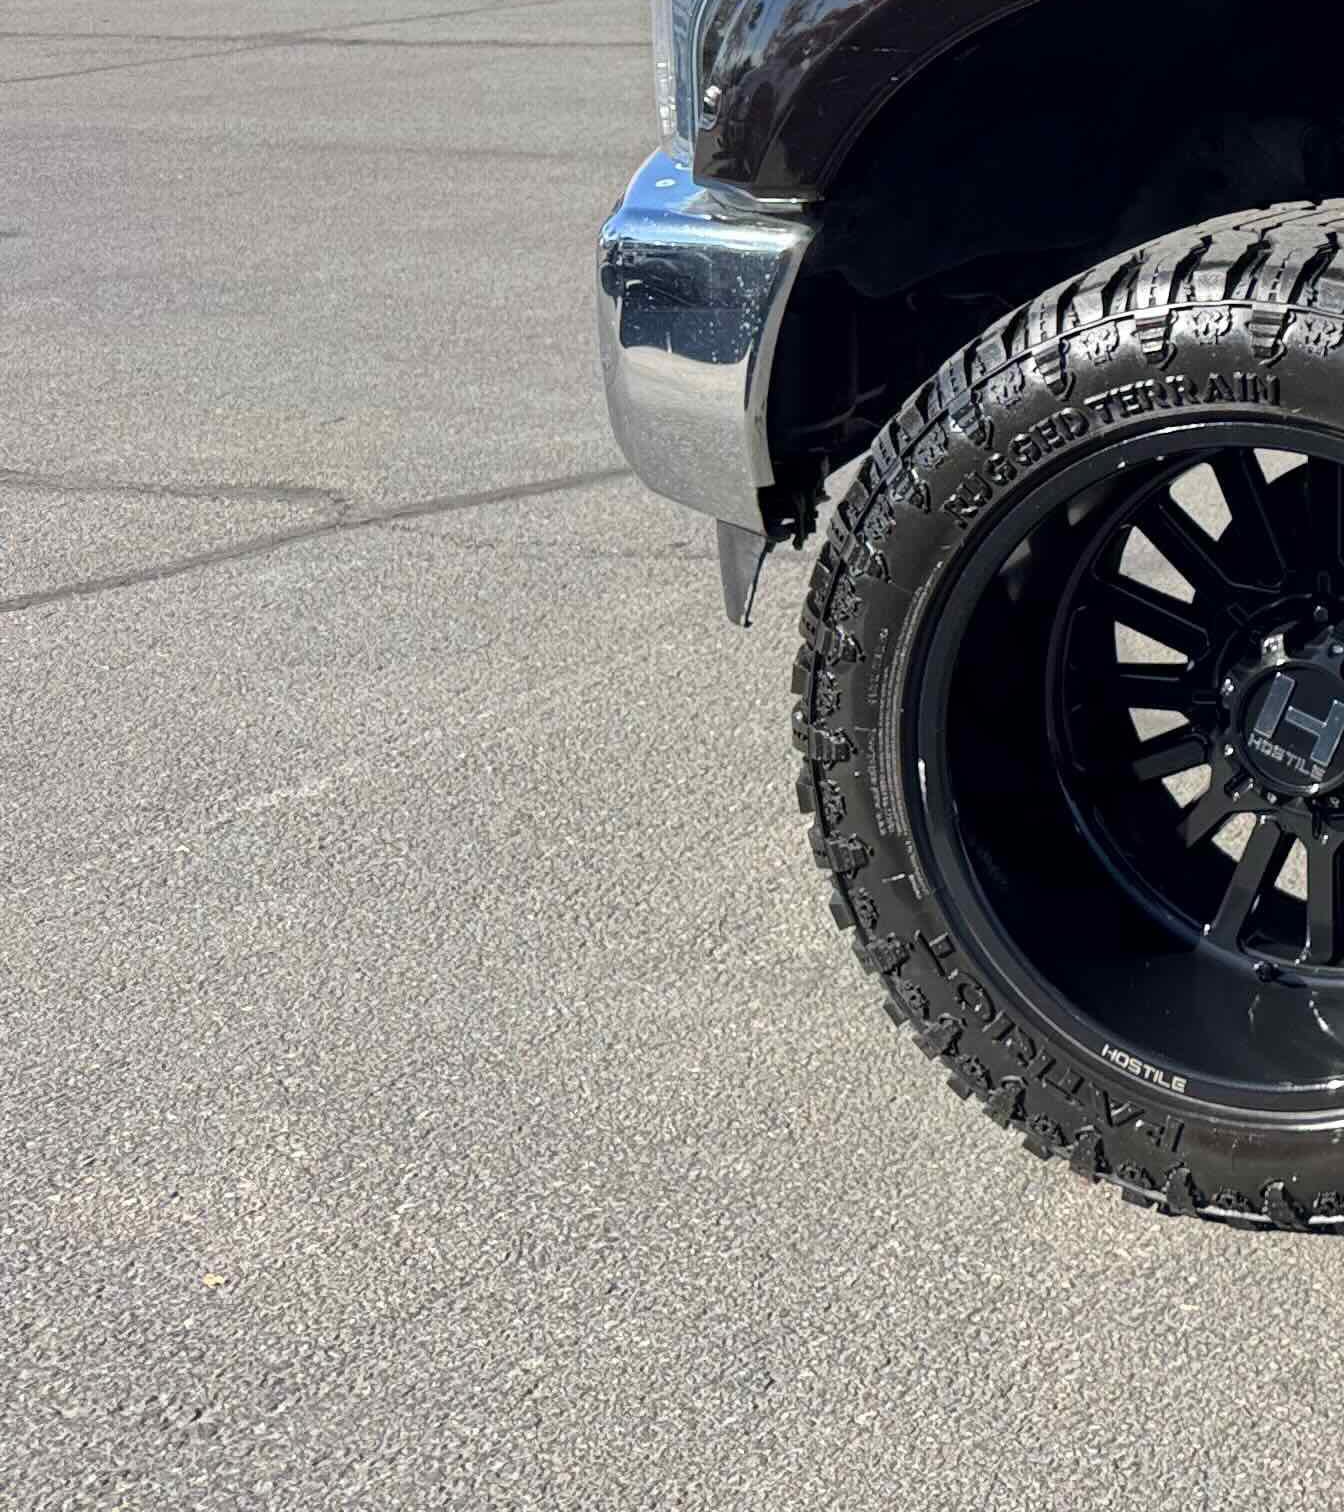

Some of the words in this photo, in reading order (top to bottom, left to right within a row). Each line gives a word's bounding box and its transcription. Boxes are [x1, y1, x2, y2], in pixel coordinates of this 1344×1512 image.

[943, 406, 1090, 529] RUGGED
[1084, 371, 1281, 425] TERRAIN
[1247, 732, 1327, 782] HOSTILE
[1101, 1043, 1188, 1093] HOSTILE
